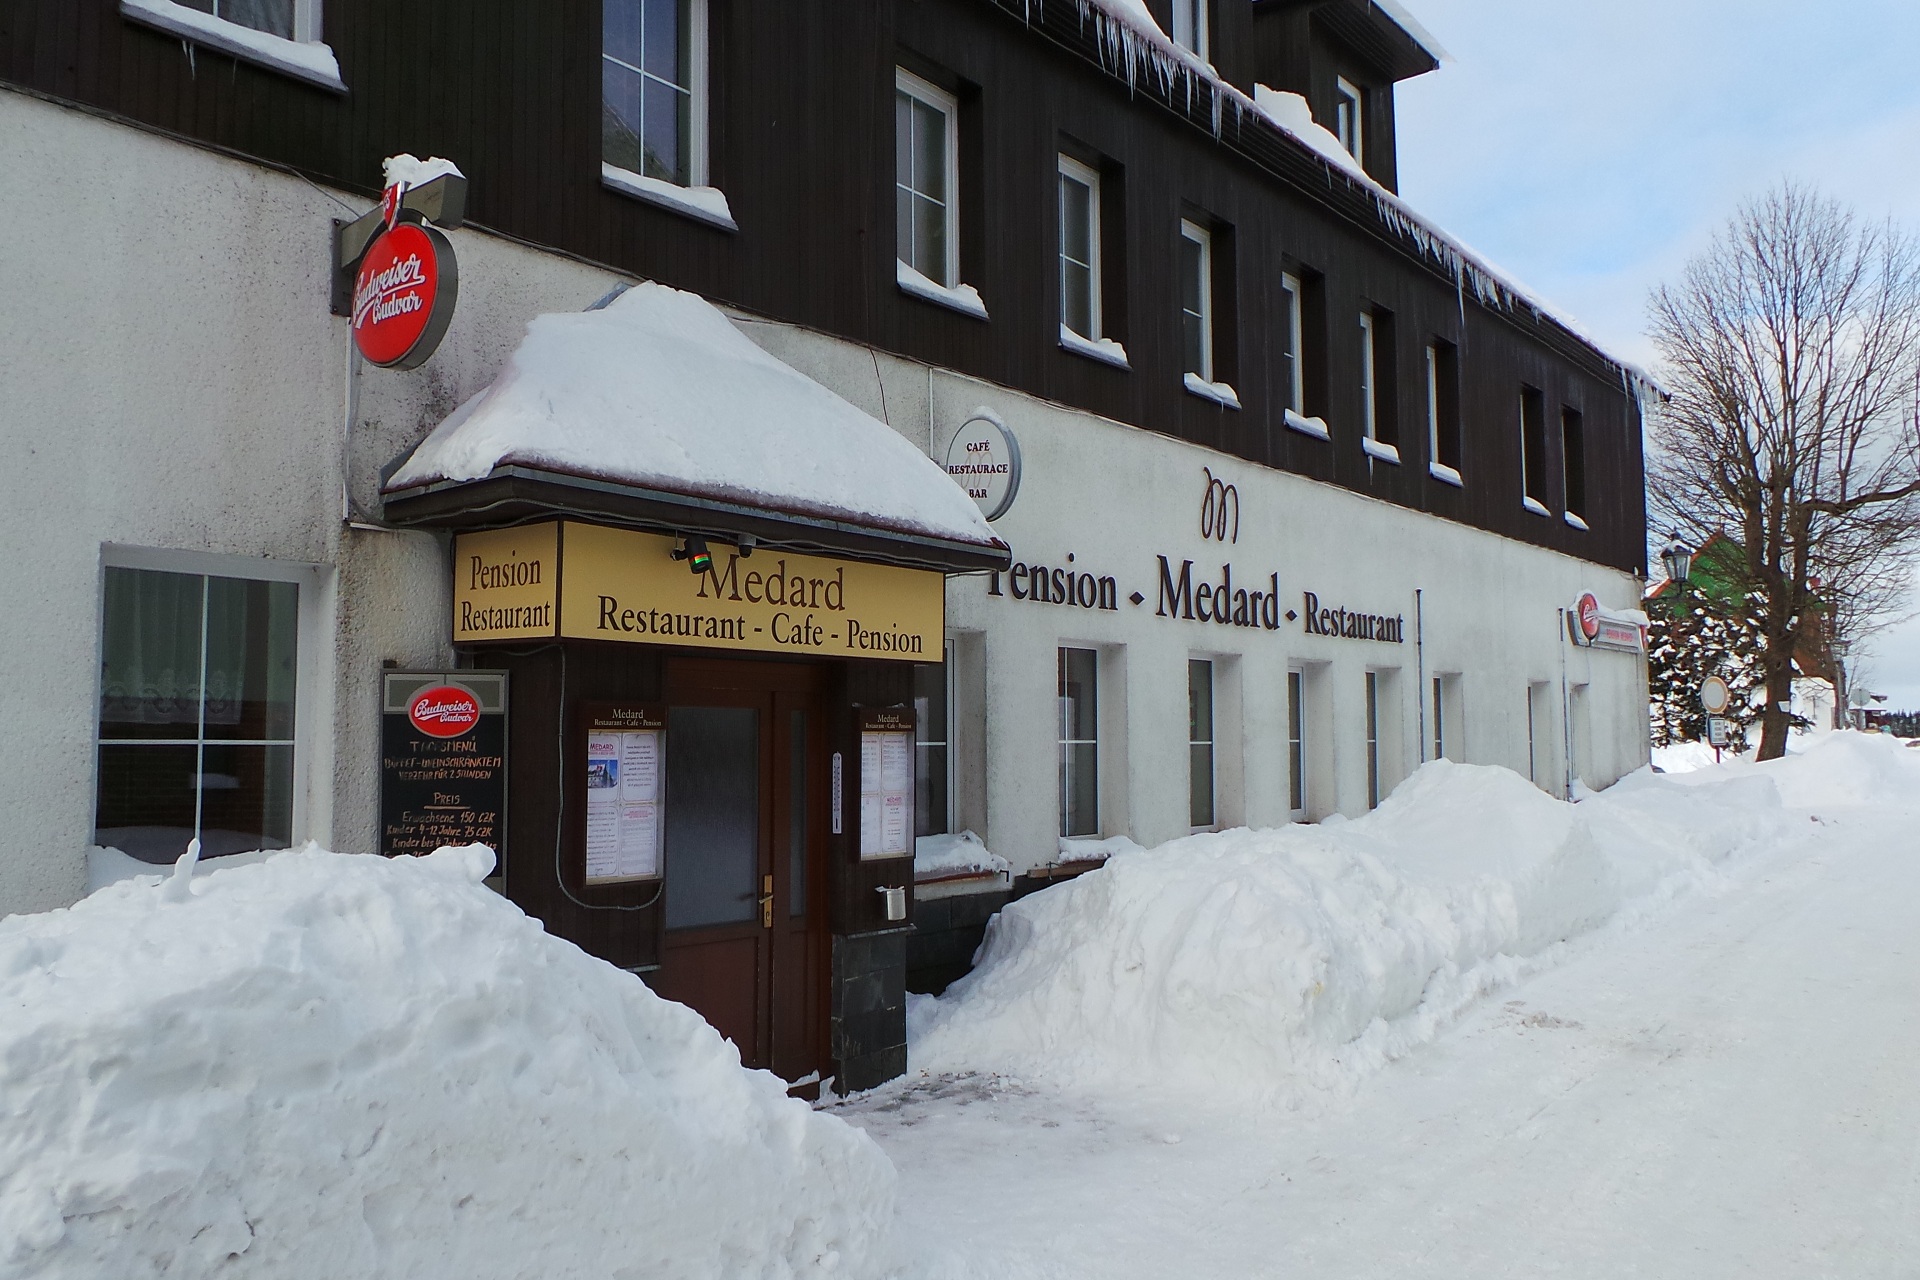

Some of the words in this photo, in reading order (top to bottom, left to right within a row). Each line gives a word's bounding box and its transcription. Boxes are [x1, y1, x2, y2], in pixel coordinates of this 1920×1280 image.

[354, 253, 425, 321] Budweiser
[372, 289, 422, 325] Budvar
[966, 440, 990, 452] CAFÉ
[948, 464, 1008, 475] RESTAURACE
[969, 489, 987, 498] BAR
[470, 549, 541, 591] Pension
[697, 553, 846, 611] Medard
[1155, 554, 1280, 631] Medard
[1304, 591, 1404, 644] Restaurant
[460, 600, 551, 632] Restaurant
[597, 595, 745, 641] Restaurant
[771, 613, 824, 647] Cafe
[846, 619, 923, 654] Pension
[415, 698, 475, 717] Budweiser
[439, 712, 473, 722] Budvar
[612, 708, 644, 719] Medard
[877, 714, 899, 723] Medard
[460, 811, 475, 823] 150
